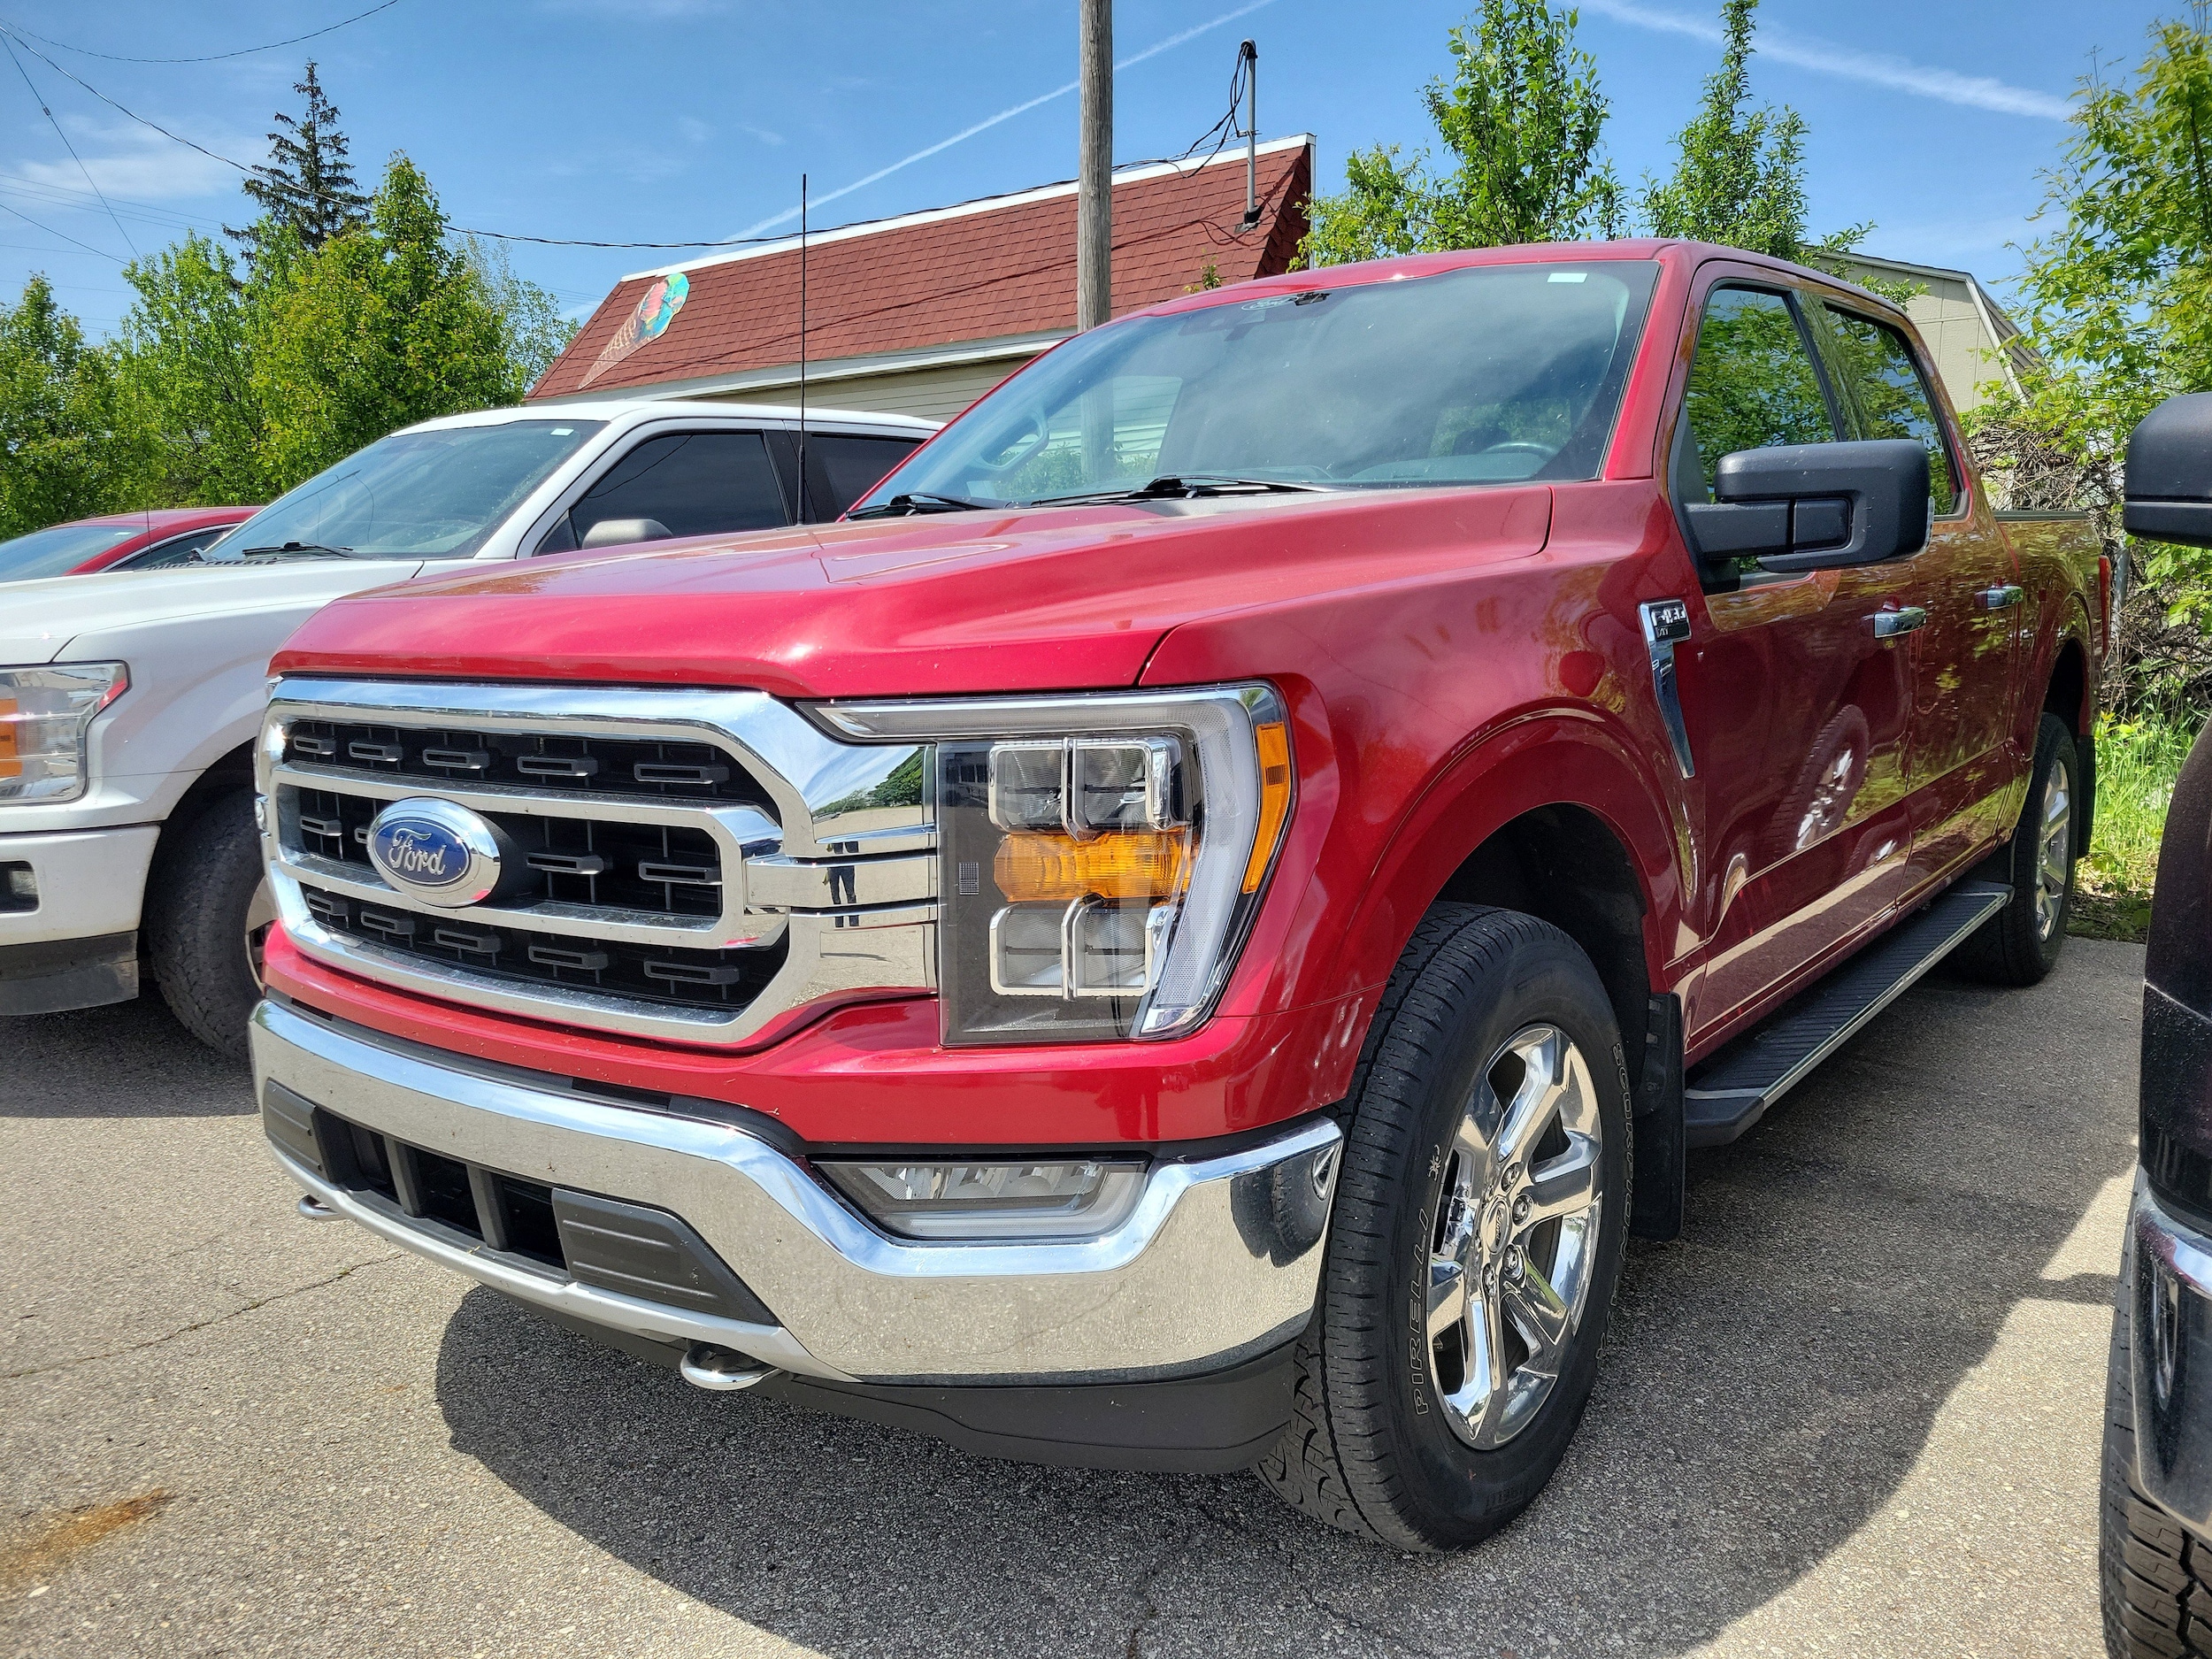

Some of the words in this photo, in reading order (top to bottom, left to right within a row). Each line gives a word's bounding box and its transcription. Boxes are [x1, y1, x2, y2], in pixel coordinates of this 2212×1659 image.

[388, 827, 447, 875] Ford
[1612, 1042, 1634, 1262] SCORPION
[1409, 1207, 1430, 1416] PIRELLI
